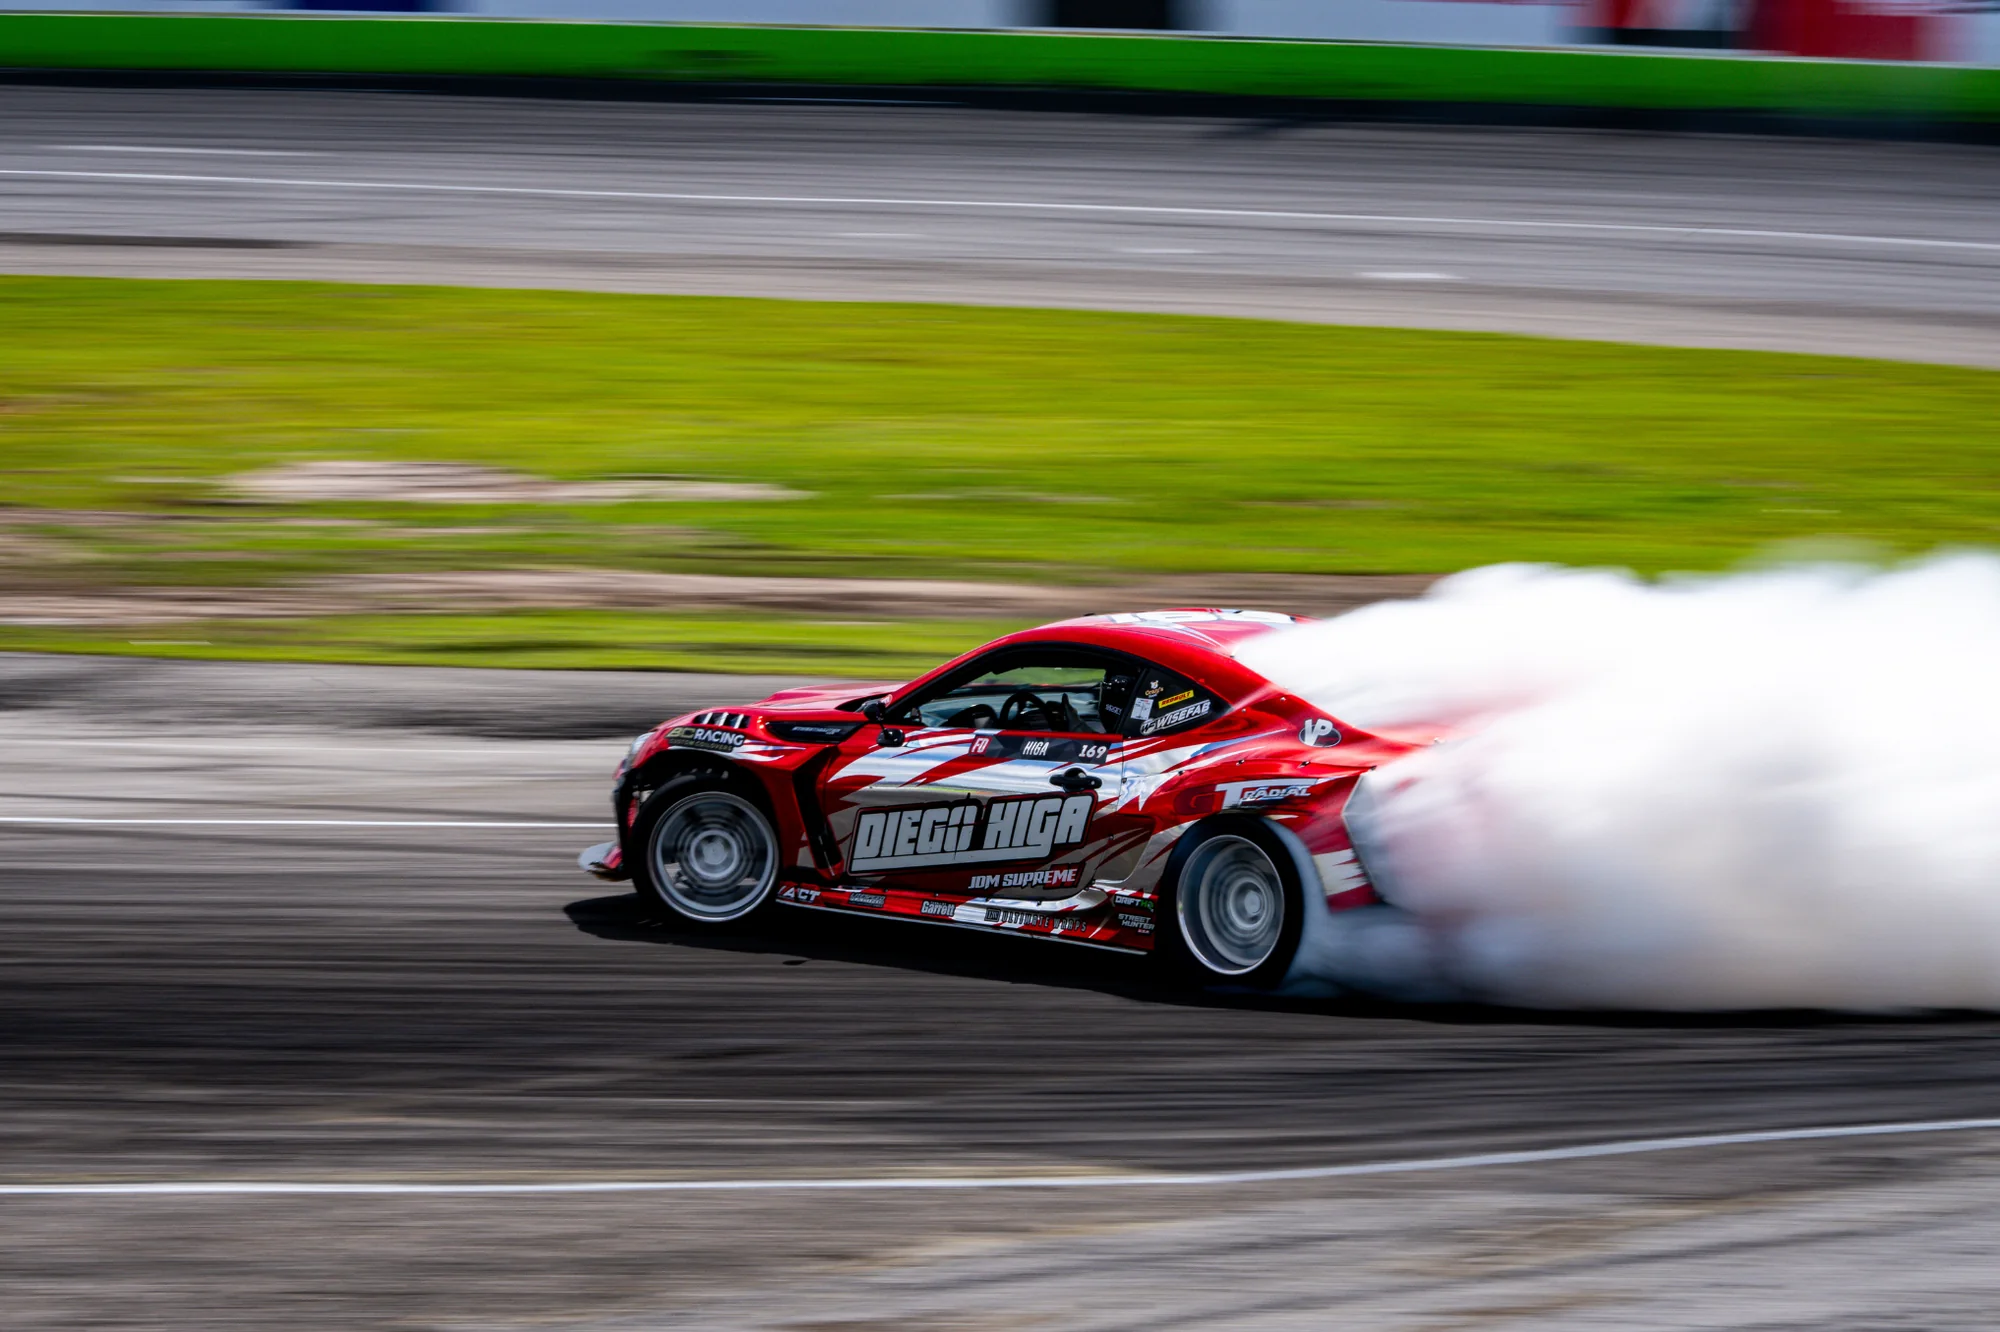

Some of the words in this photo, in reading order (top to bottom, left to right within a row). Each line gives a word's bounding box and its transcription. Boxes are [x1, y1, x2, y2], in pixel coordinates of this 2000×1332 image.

[1157, 701, 1211, 728] WISEFAB
[693, 728, 745, 746] RACING
[1304, 718, 1333, 746] VP
[971, 737, 989, 753] FD
[1022, 741, 1050, 756] HIGA
[1078, 744, 1107, 759] 169
[852, 805, 978, 859] DIEGO
[983, 795, 1093, 860] HIGA
[968, 873, 1001, 890] JDM
[1002, 868, 1078, 888] SUPREME
[782, 886, 821, 901] ACT
[921, 900, 955, 916] Garrett
[1118, 913, 1151, 923] STREET
[1001, 910, 1049, 927] ULTIMATE
[1053, 918, 1087, 932] WRAPS
[1121, 920, 1155, 931] HUNTER
